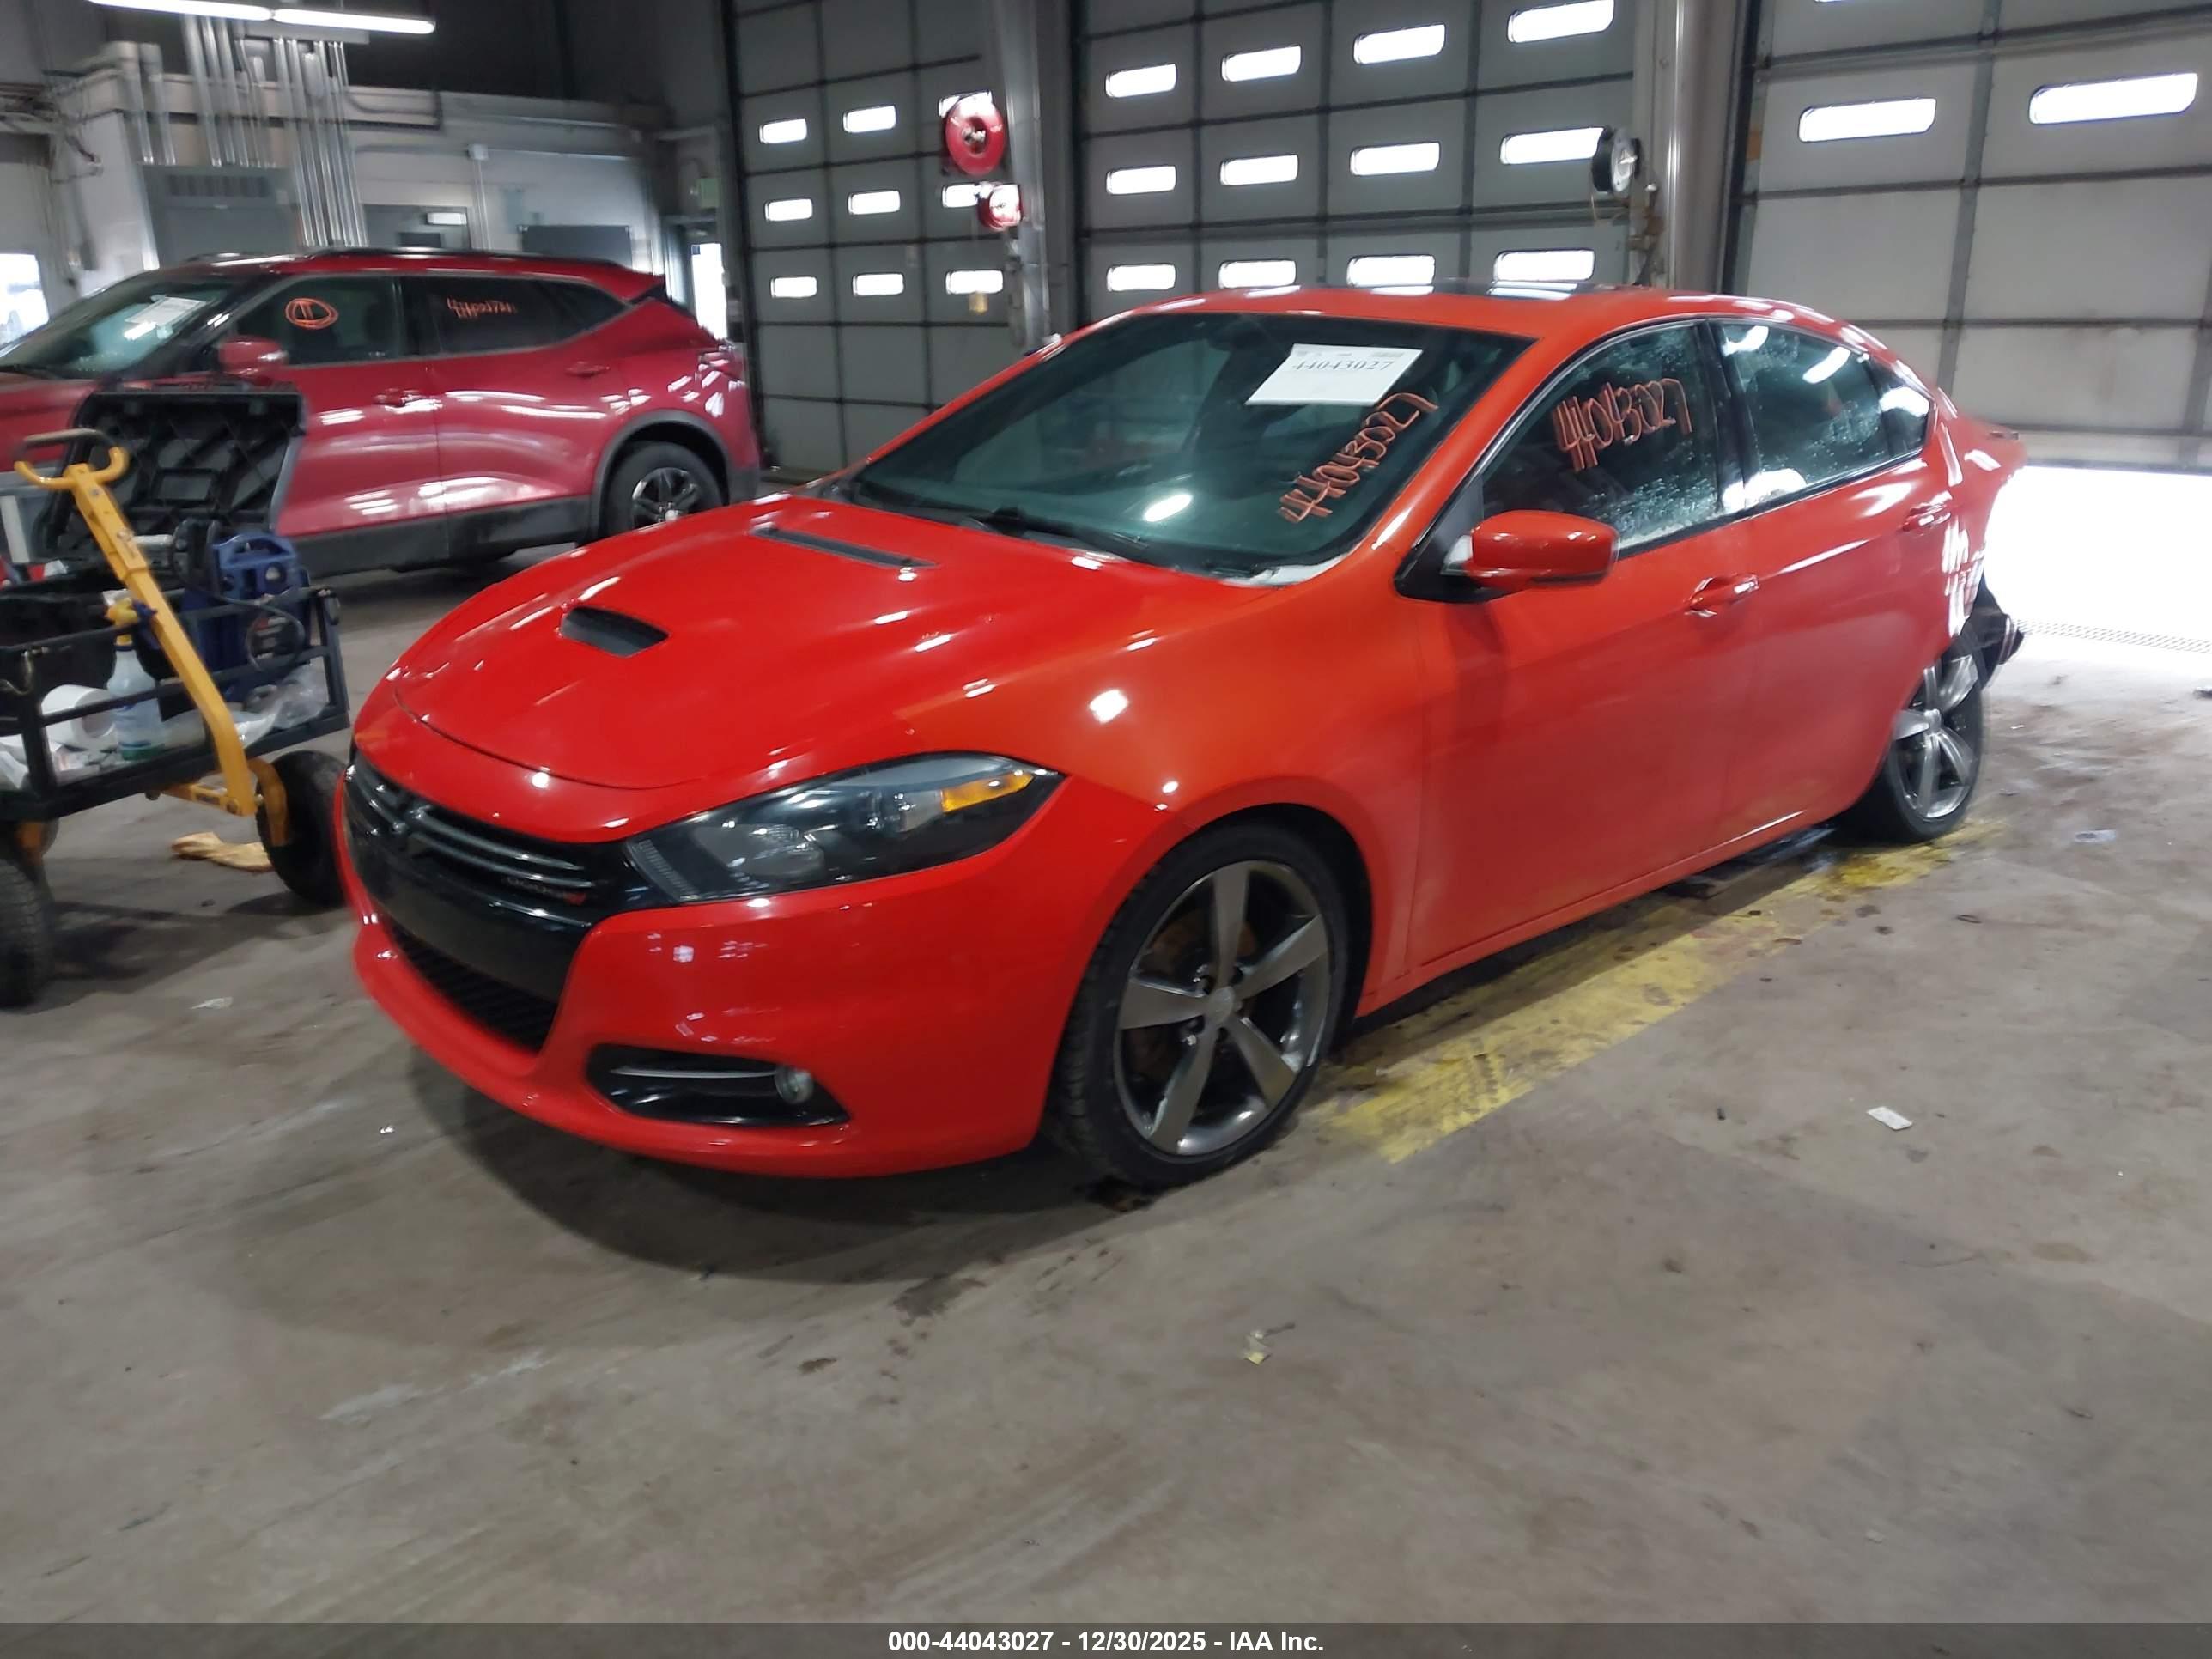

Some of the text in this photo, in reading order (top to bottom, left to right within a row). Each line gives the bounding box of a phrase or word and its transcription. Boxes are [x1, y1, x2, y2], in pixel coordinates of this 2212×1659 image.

[1292, 360, 1395, 371] 44043027
[1278, 392, 1439, 522] 44043027
[1554, 378, 1692, 471] 44043027
